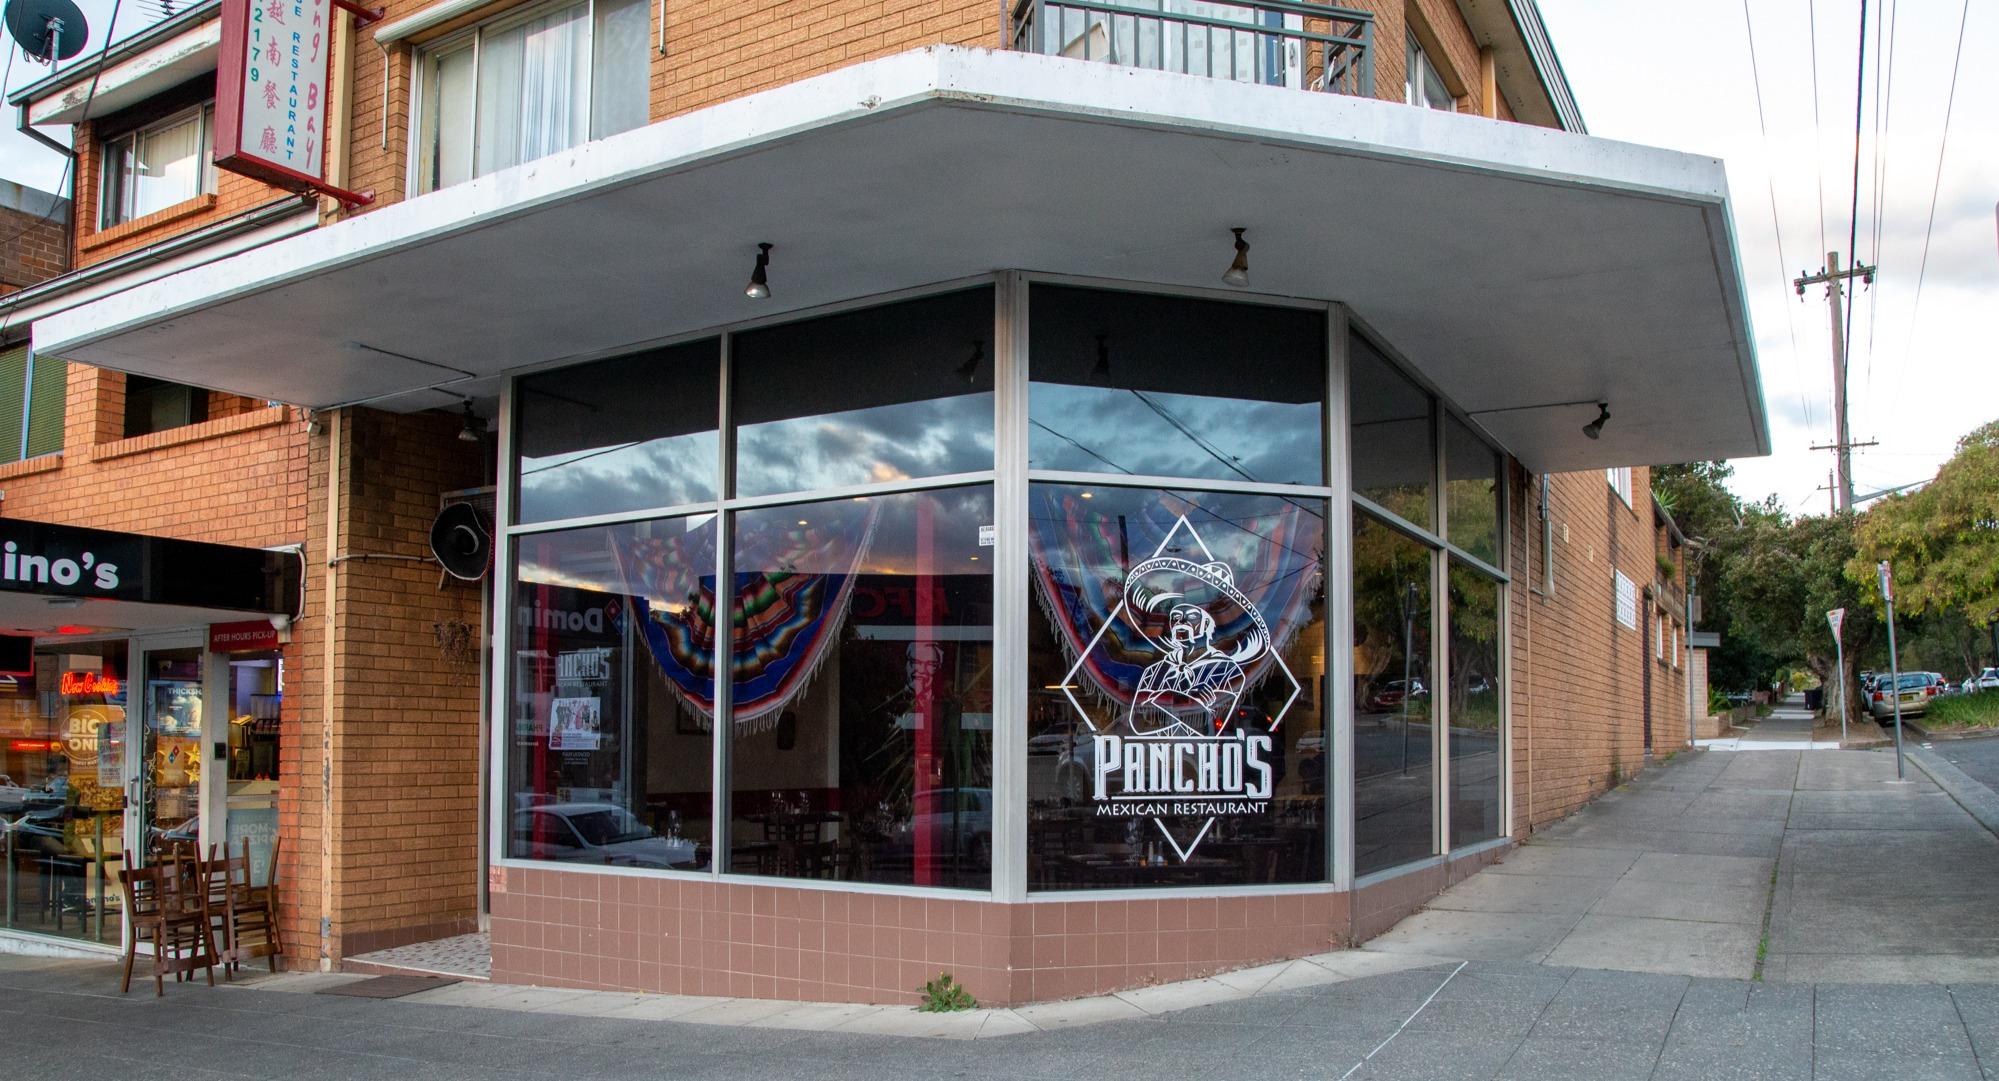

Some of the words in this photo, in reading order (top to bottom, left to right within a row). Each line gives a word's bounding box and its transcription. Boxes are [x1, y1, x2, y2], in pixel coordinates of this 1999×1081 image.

[250, 0, 263, 82] 2179
[286, 31, 301, 160] RESTAURANT
[306, 82, 318, 169] Bay
[4, 540, 119, 590] ino's
[214, 633, 230, 642] AFTER
[231, 632, 252, 641] HOURS
[252, 630, 276, 640] PICK-UP
[1092, 728, 1272, 801] PANCHO'S
[1096, 802, 1168, 816] MEXICAN
[1173, 801, 1268, 815] RESTAURANT
